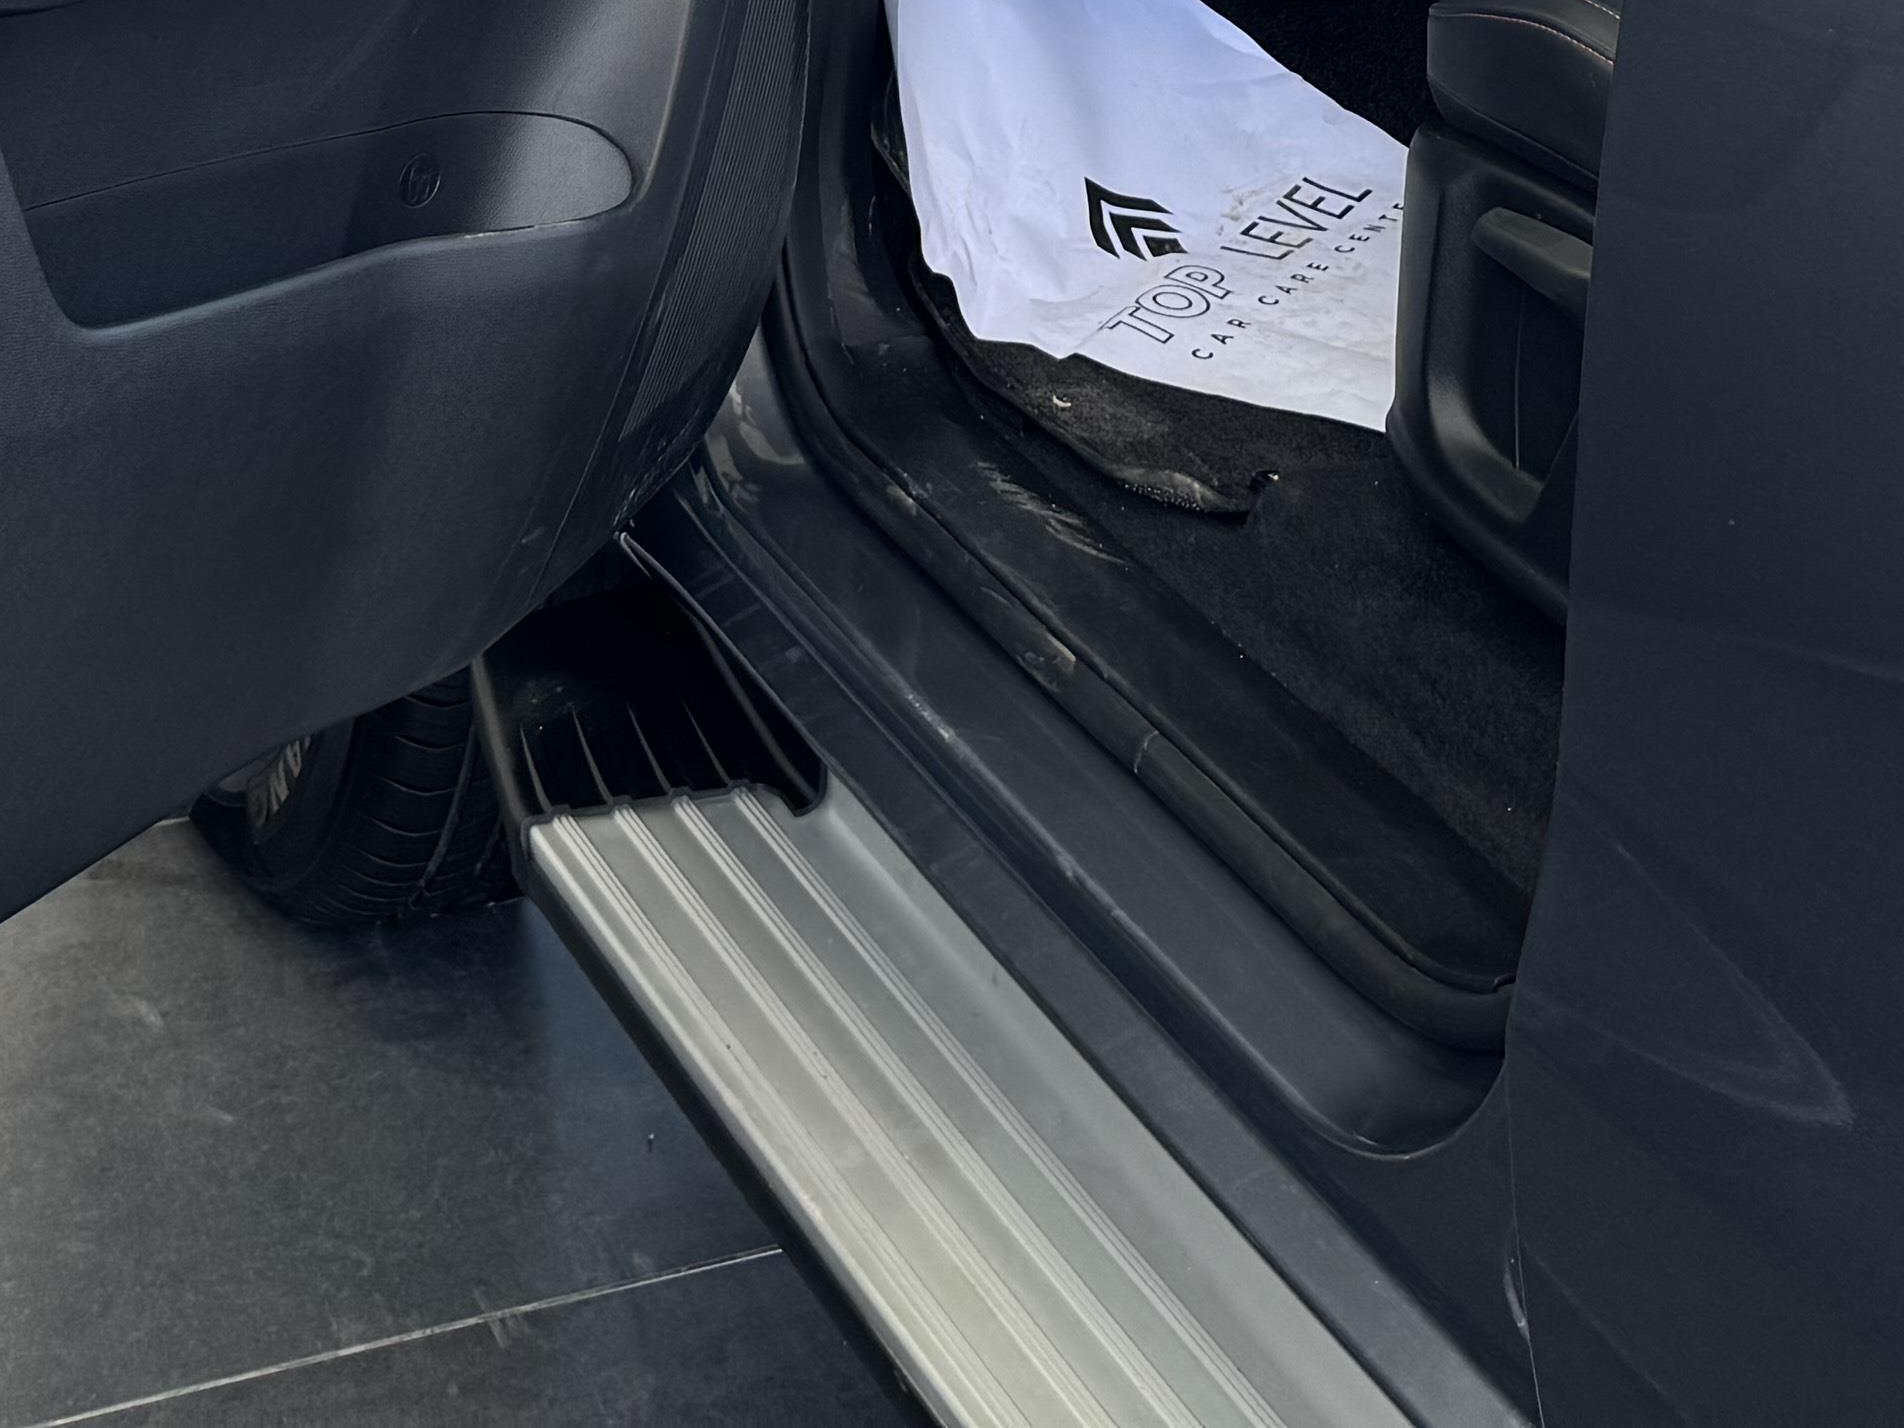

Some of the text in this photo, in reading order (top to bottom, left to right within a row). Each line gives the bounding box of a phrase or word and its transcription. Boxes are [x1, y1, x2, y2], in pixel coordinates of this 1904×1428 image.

[1099, 176, 1373, 344] TOP LEVEL
[1191, 317, 1252, 360] CAR
[1257, 261, 1329, 306] CARE
